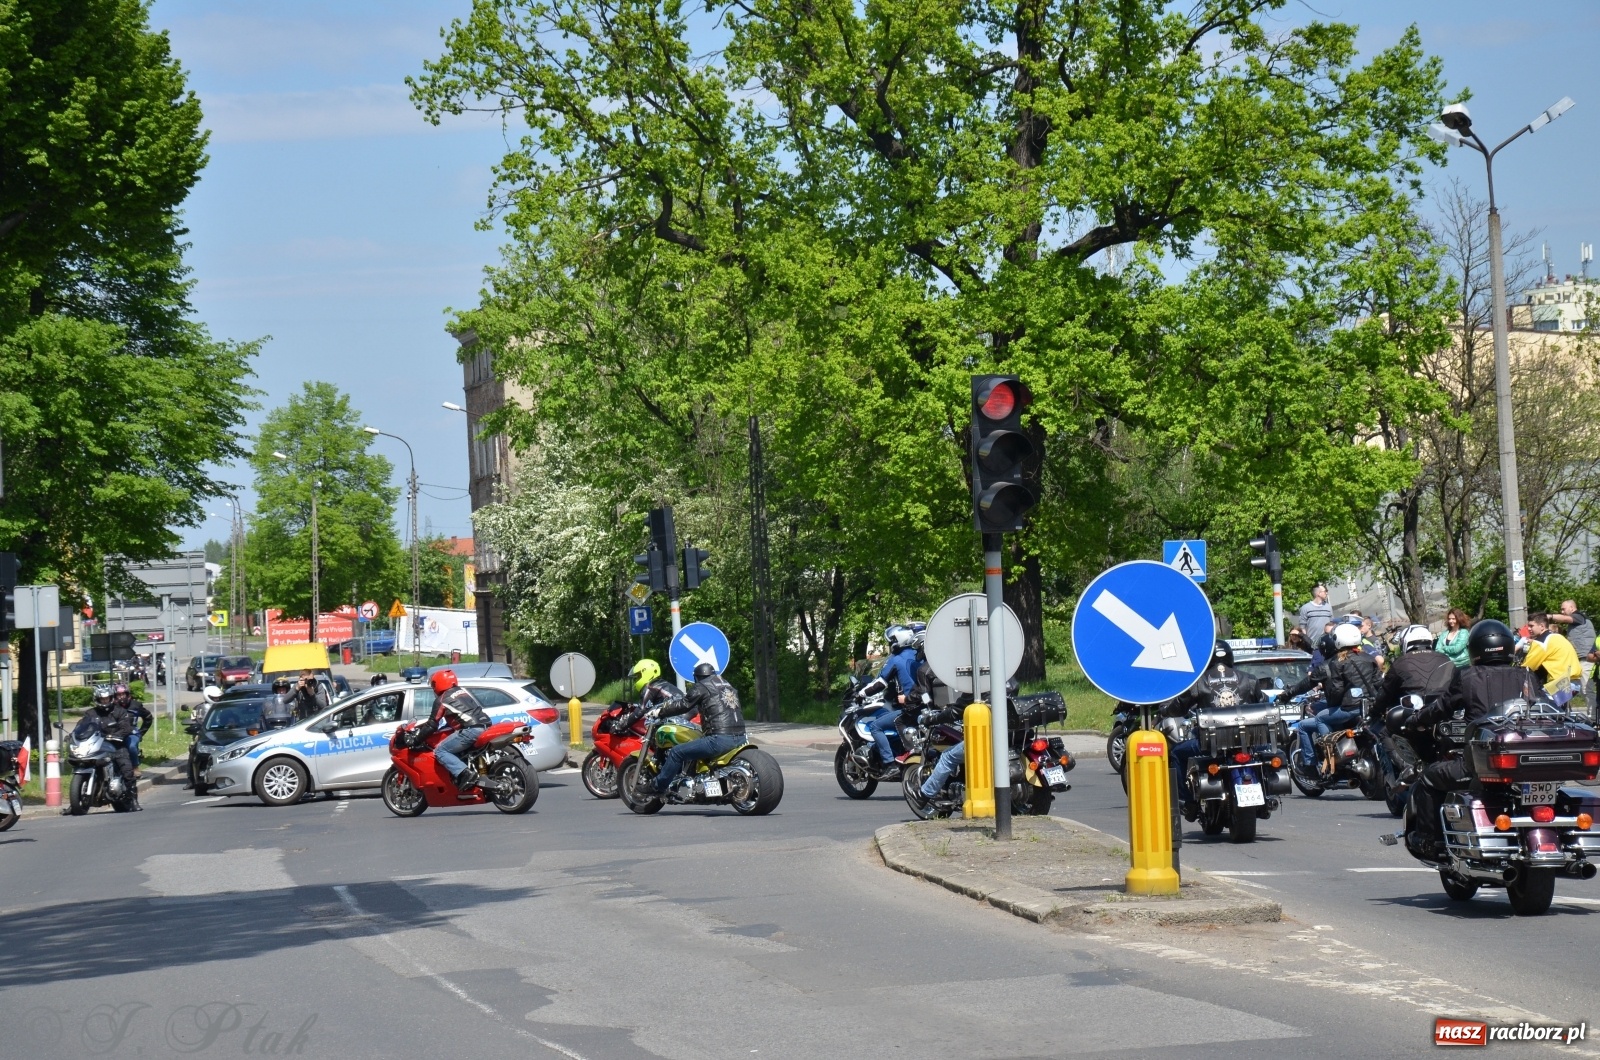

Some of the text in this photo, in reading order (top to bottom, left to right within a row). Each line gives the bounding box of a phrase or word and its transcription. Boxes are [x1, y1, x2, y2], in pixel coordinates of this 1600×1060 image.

[634, 609, 648, 626] P
[328, 736, 374, 750] POLICJA
[1531, 783, 1552, 792] SWD
[1524, 794, 1554, 803] HR99
